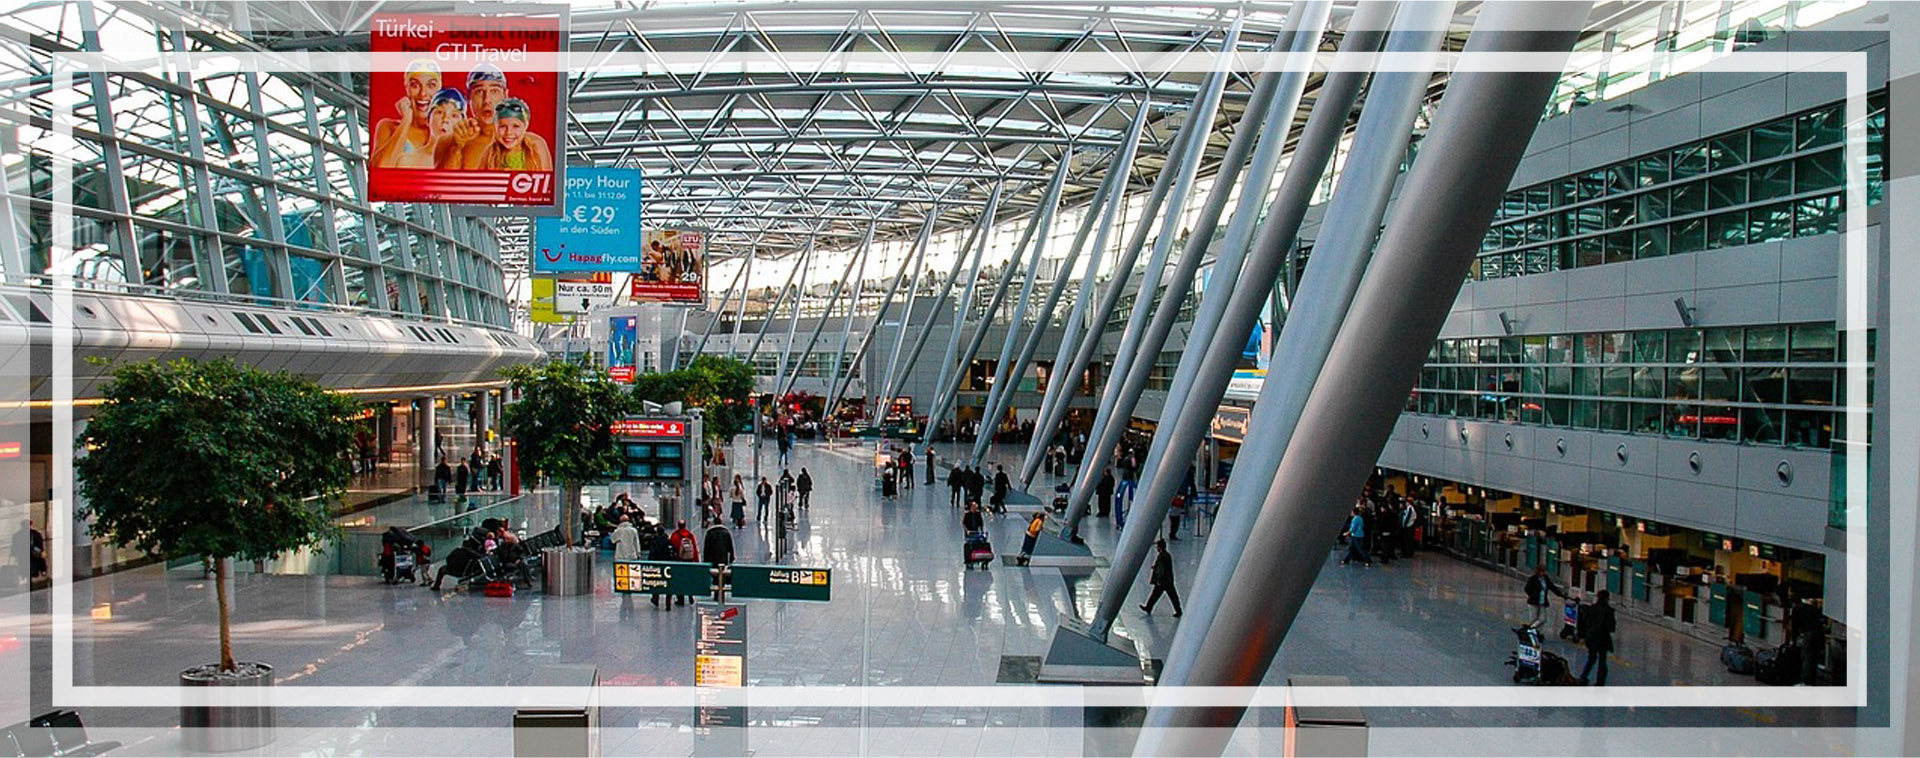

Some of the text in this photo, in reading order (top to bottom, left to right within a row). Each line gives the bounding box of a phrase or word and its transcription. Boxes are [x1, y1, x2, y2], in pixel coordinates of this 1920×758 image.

[375, 19, 434, 39] Türkei
[449, 21, 504, 40] bucht
[509, 26, 555, 40] man
[435, 43, 468, 62] GTI
[471, 43, 528, 63] Travel
[511, 172, 551, 194] GTI
[565, 174, 631, 190] ppy Hour
[560, 224, 620, 235] in den Süden
[569, 252, 639, 264] Hapagfly.com
[558, 284, 574, 292] Nur
[576, 285, 590, 293] ca.
[591, 284, 604, 293] 50
[663, 566, 672, 578] C
[791, 570, 800, 583] B
